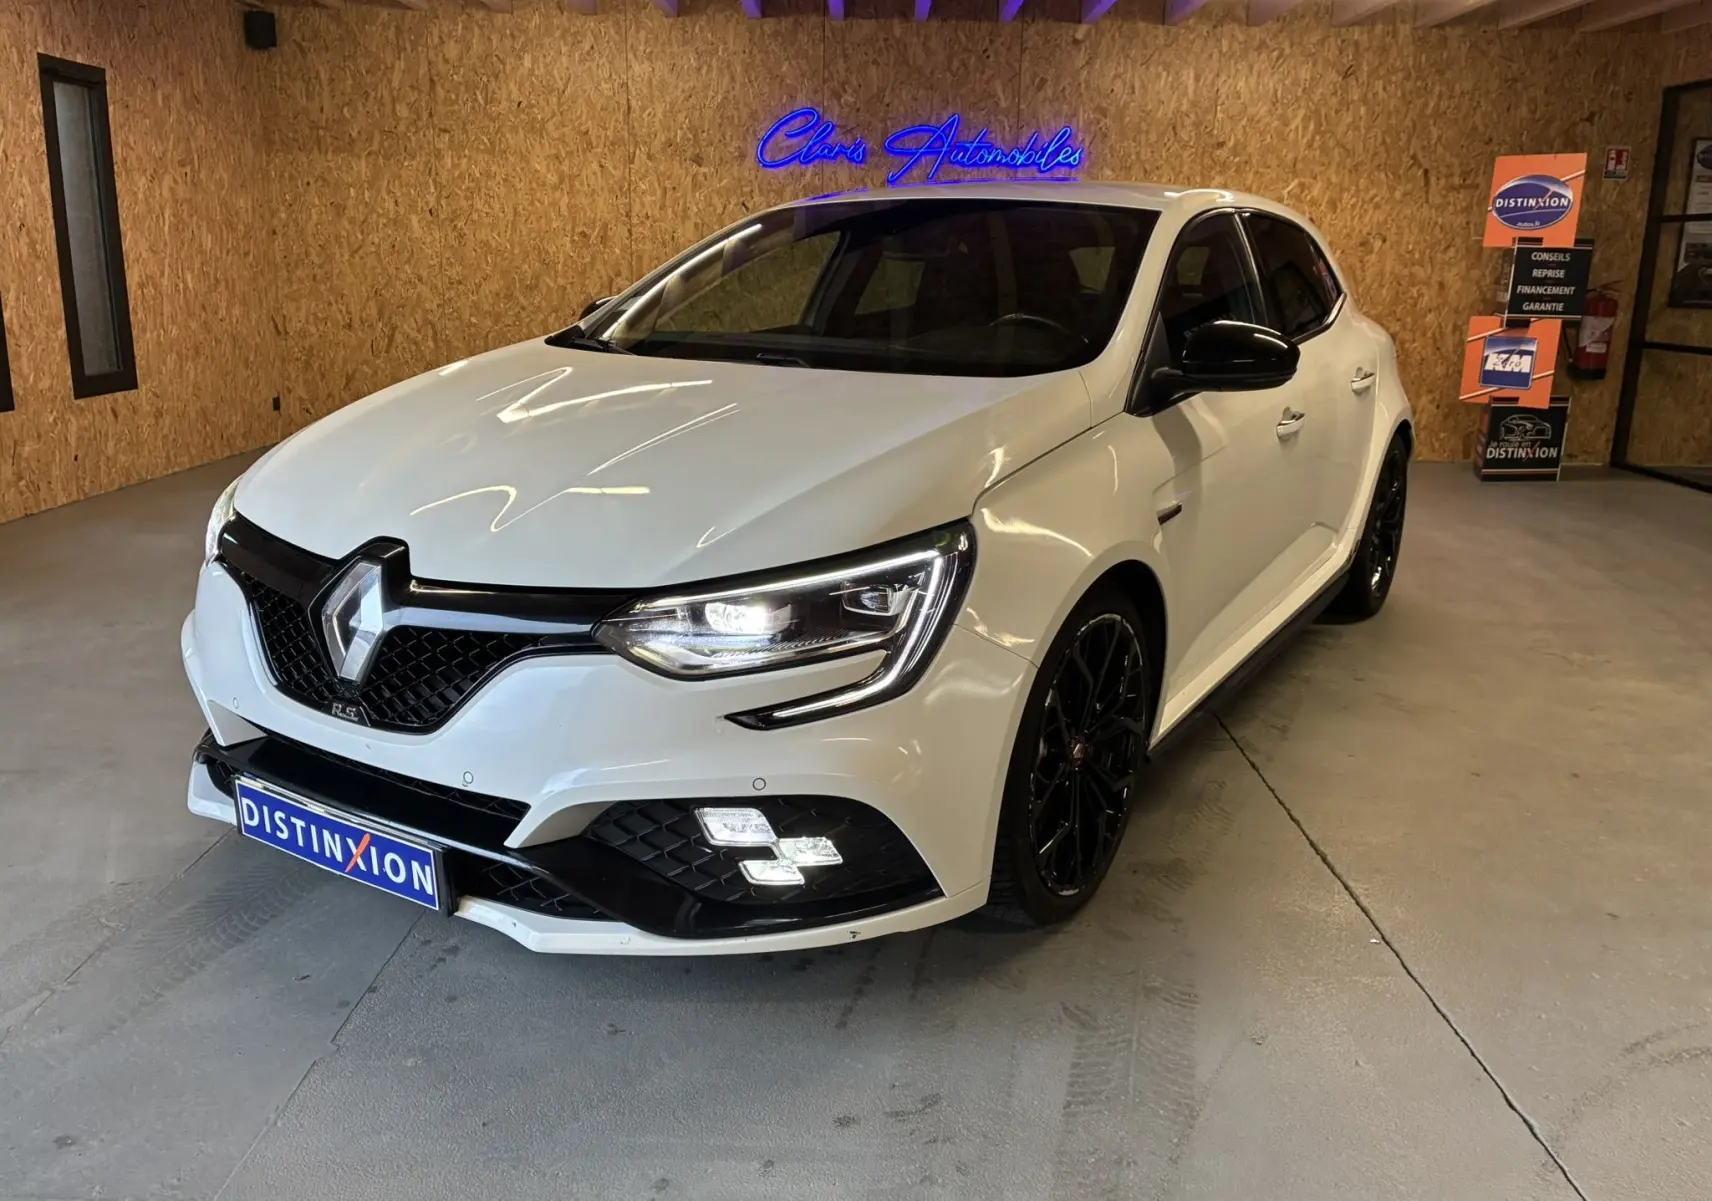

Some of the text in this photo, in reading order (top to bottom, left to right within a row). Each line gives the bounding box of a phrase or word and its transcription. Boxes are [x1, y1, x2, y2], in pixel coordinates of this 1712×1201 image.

[757, 107, 1083, 183] Claris Automobiles
[1495, 195, 1569, 210] DISTINXION
[1531, 251, 1571, 262] CONSEILS
[1531, 268, 1566, 278] REPRISE
[1516, 285, 1576, 295] FINANCEMENT
[1522, 302, 1565, 311] GARANTIE
[1486, 445, 1559, 460] DISTINXION
[241, 797, 433, 896] DISTINXION
